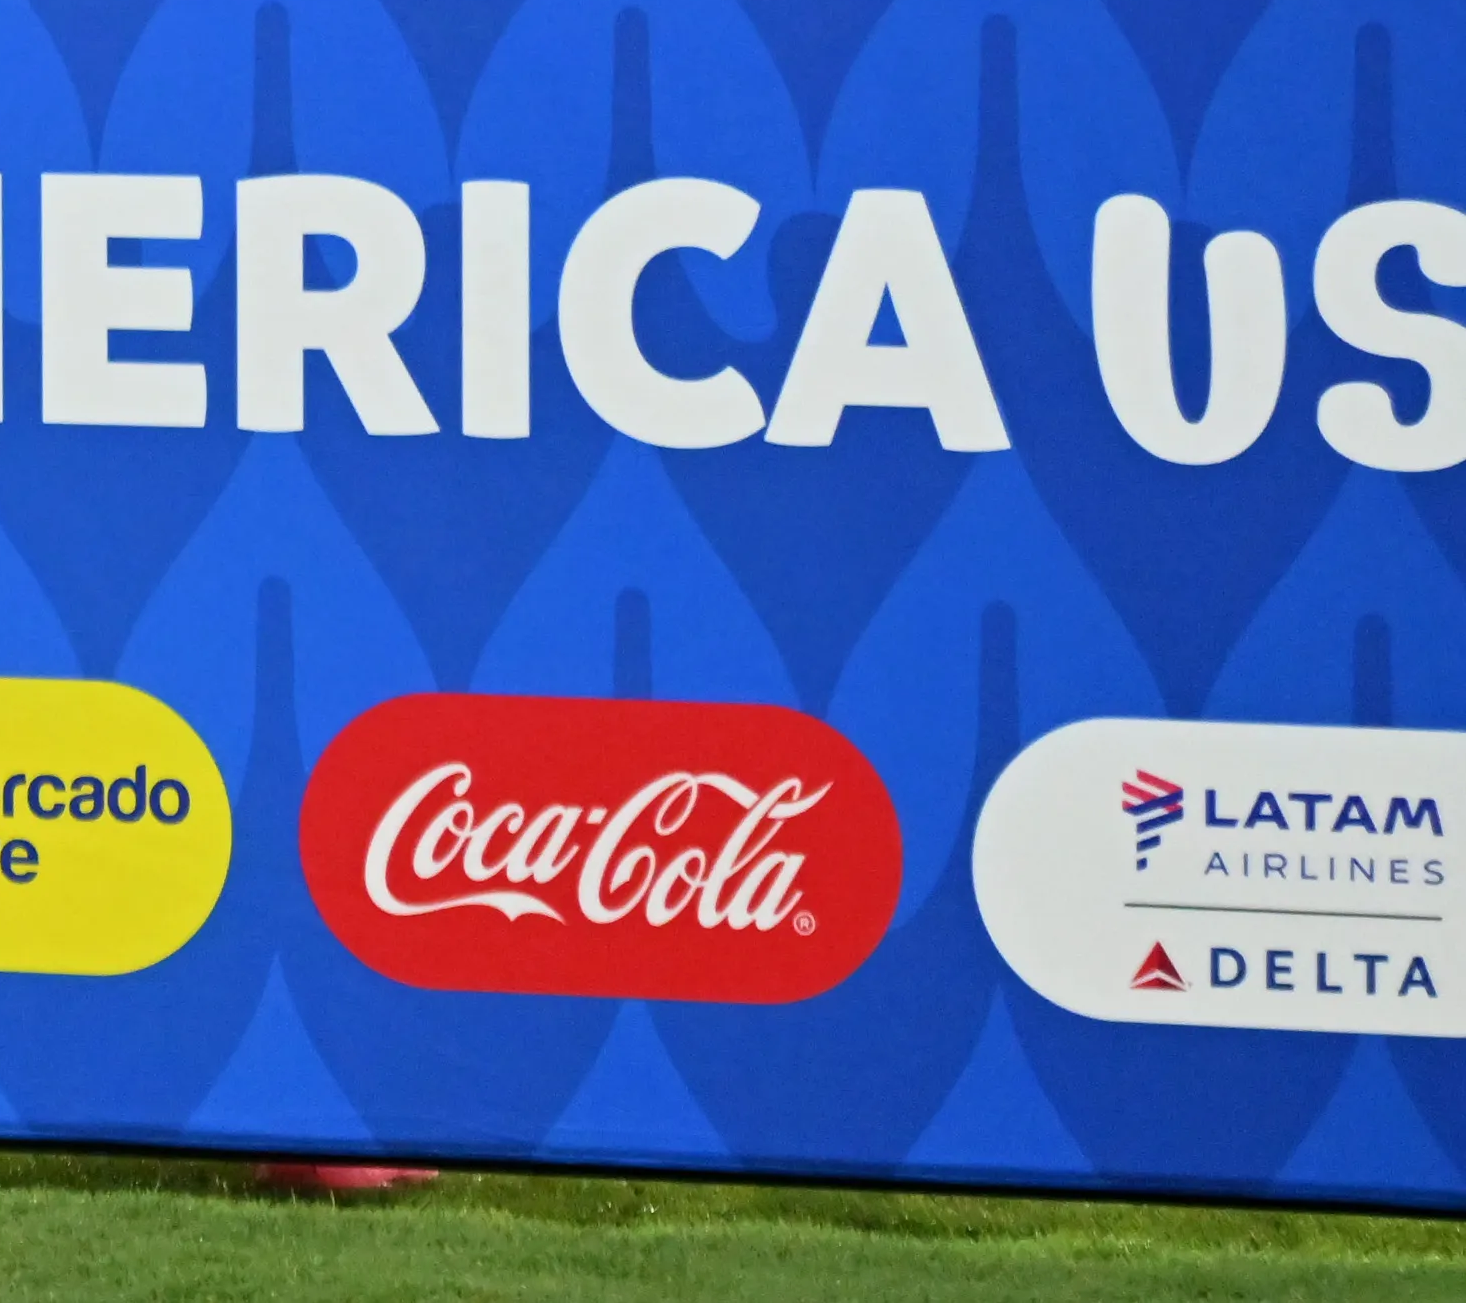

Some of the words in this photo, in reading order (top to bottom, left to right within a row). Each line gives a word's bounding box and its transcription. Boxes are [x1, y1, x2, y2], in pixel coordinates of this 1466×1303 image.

[1204, 788, 1444, 837] LATAM
[364, 761, 834, 934] Coca-Cola
[1204, 850, 1446, 887] AIRLINES
[1210, 946, 1439, 999] DELTA
